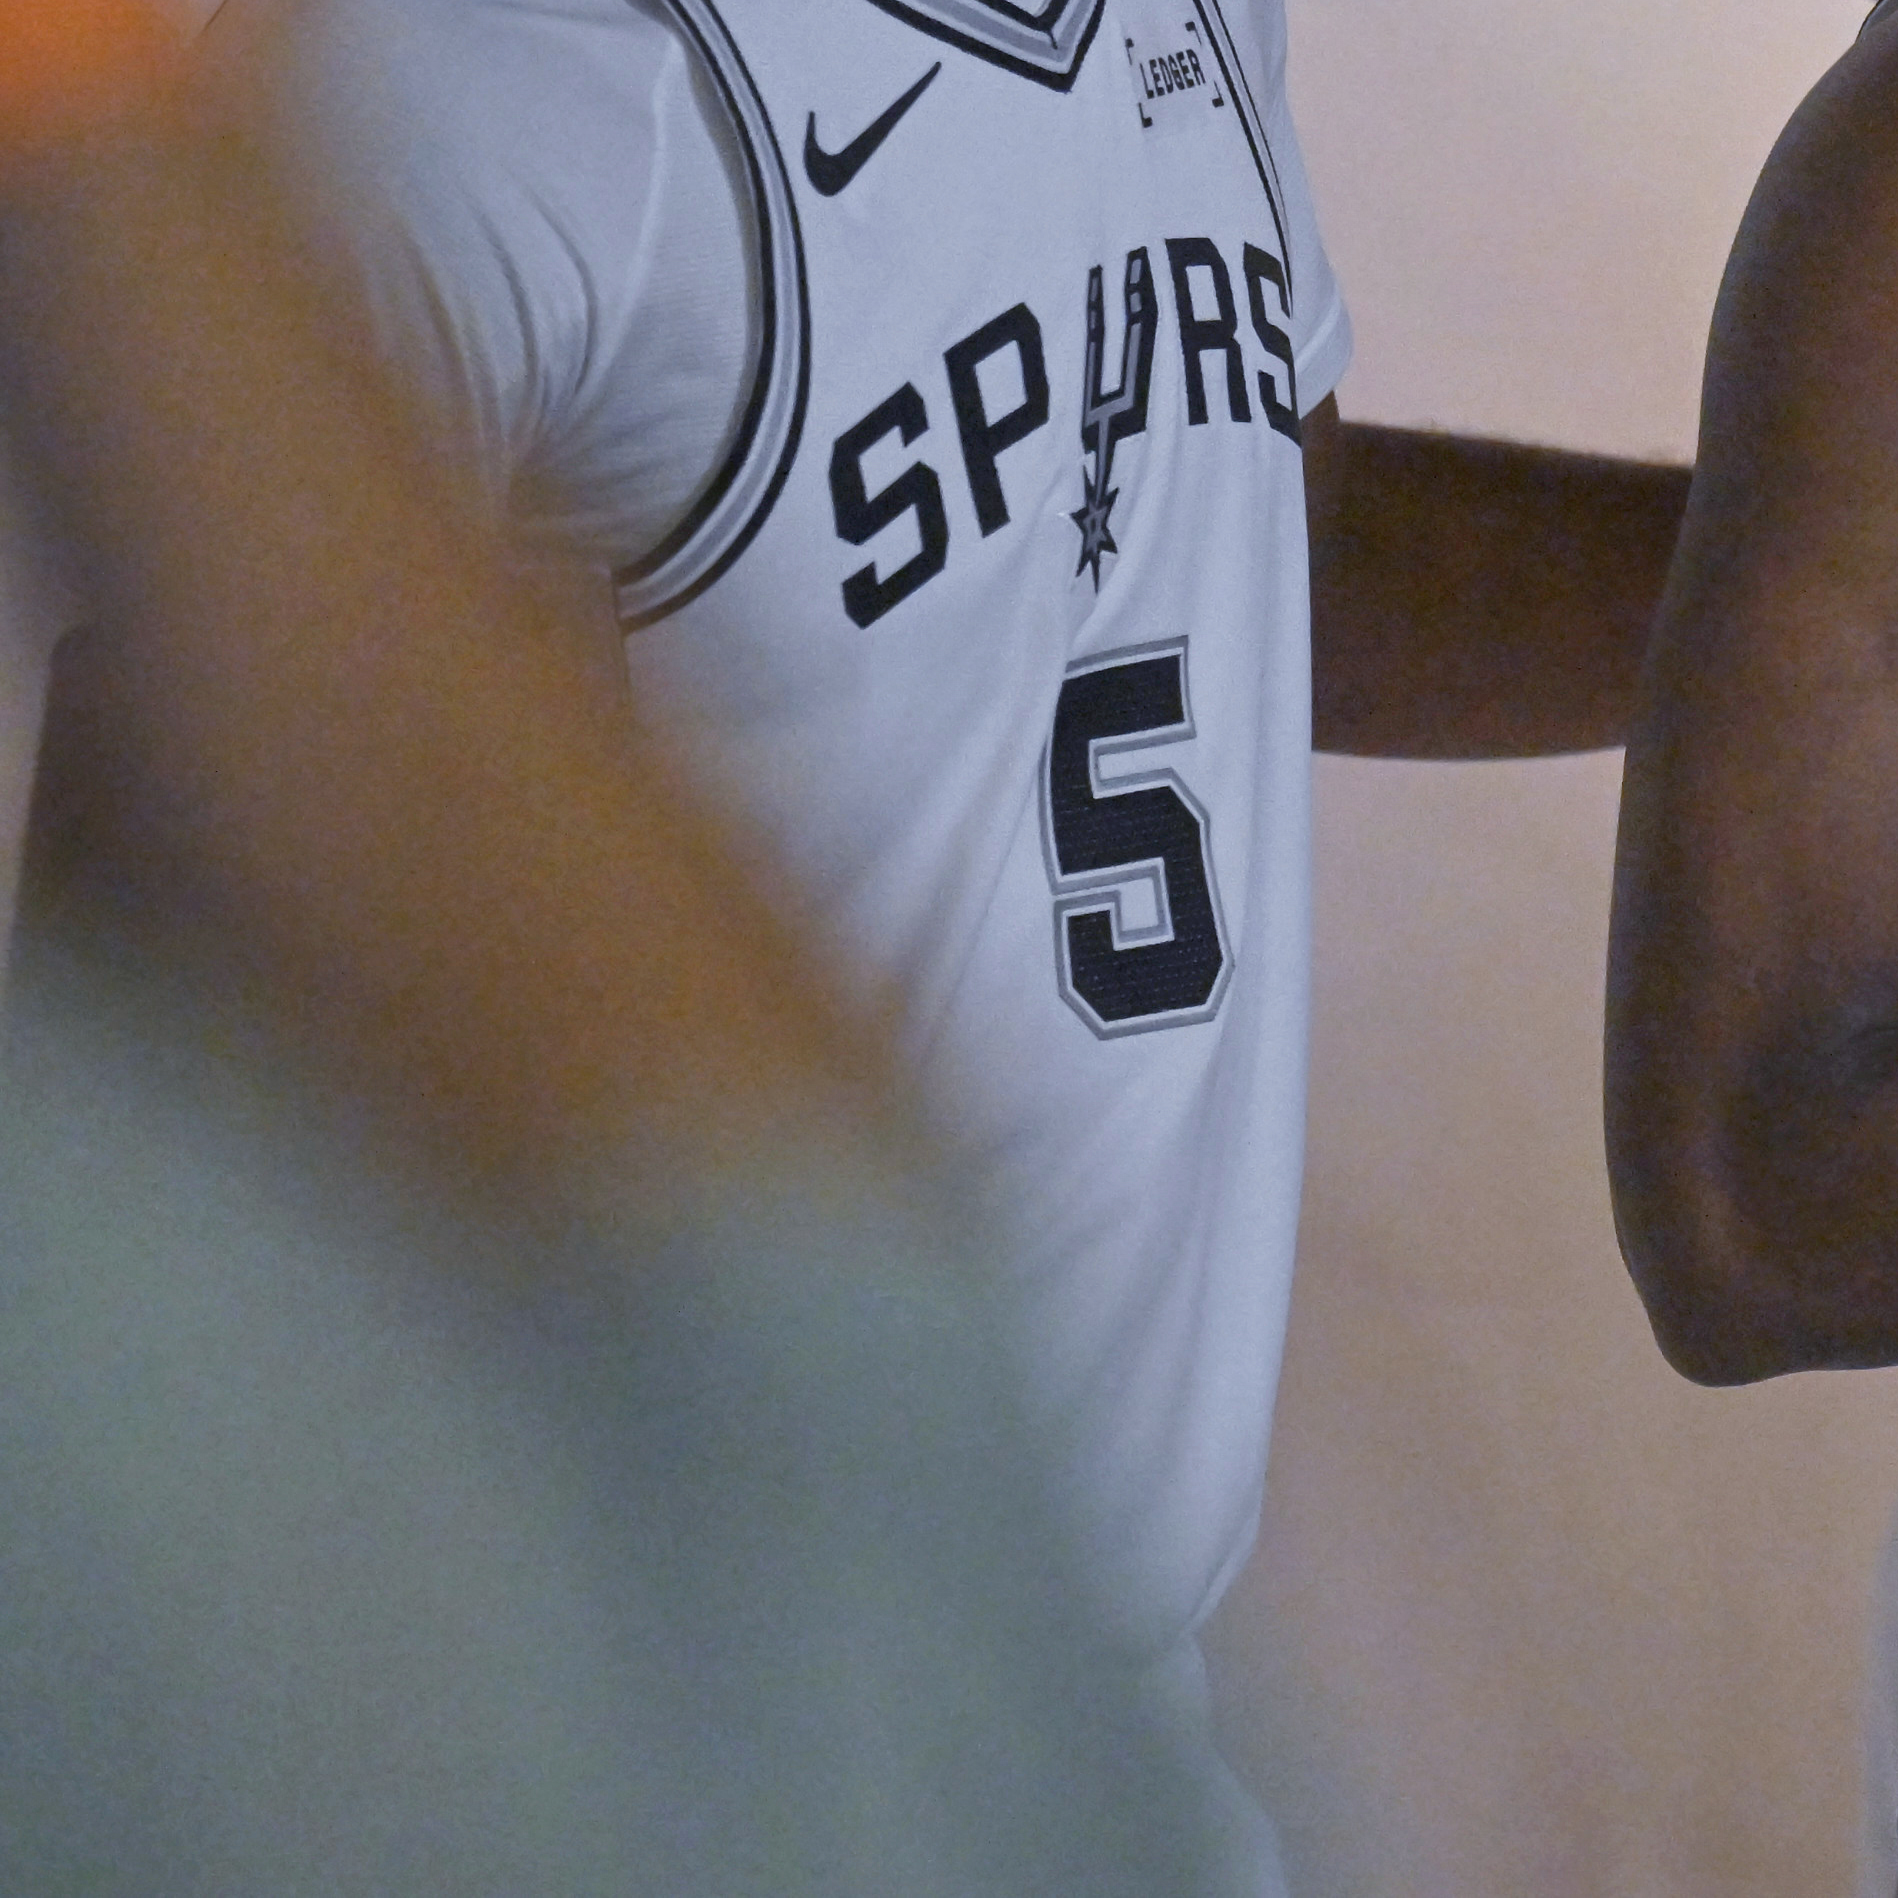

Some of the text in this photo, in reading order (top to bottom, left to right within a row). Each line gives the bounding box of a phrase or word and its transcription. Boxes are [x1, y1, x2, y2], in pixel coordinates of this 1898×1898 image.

[1140, 48, 1206, 100] LEDGER
[828, 237, 1302, 629] SPURS
[1038, 635, 1236, 1040] 5
